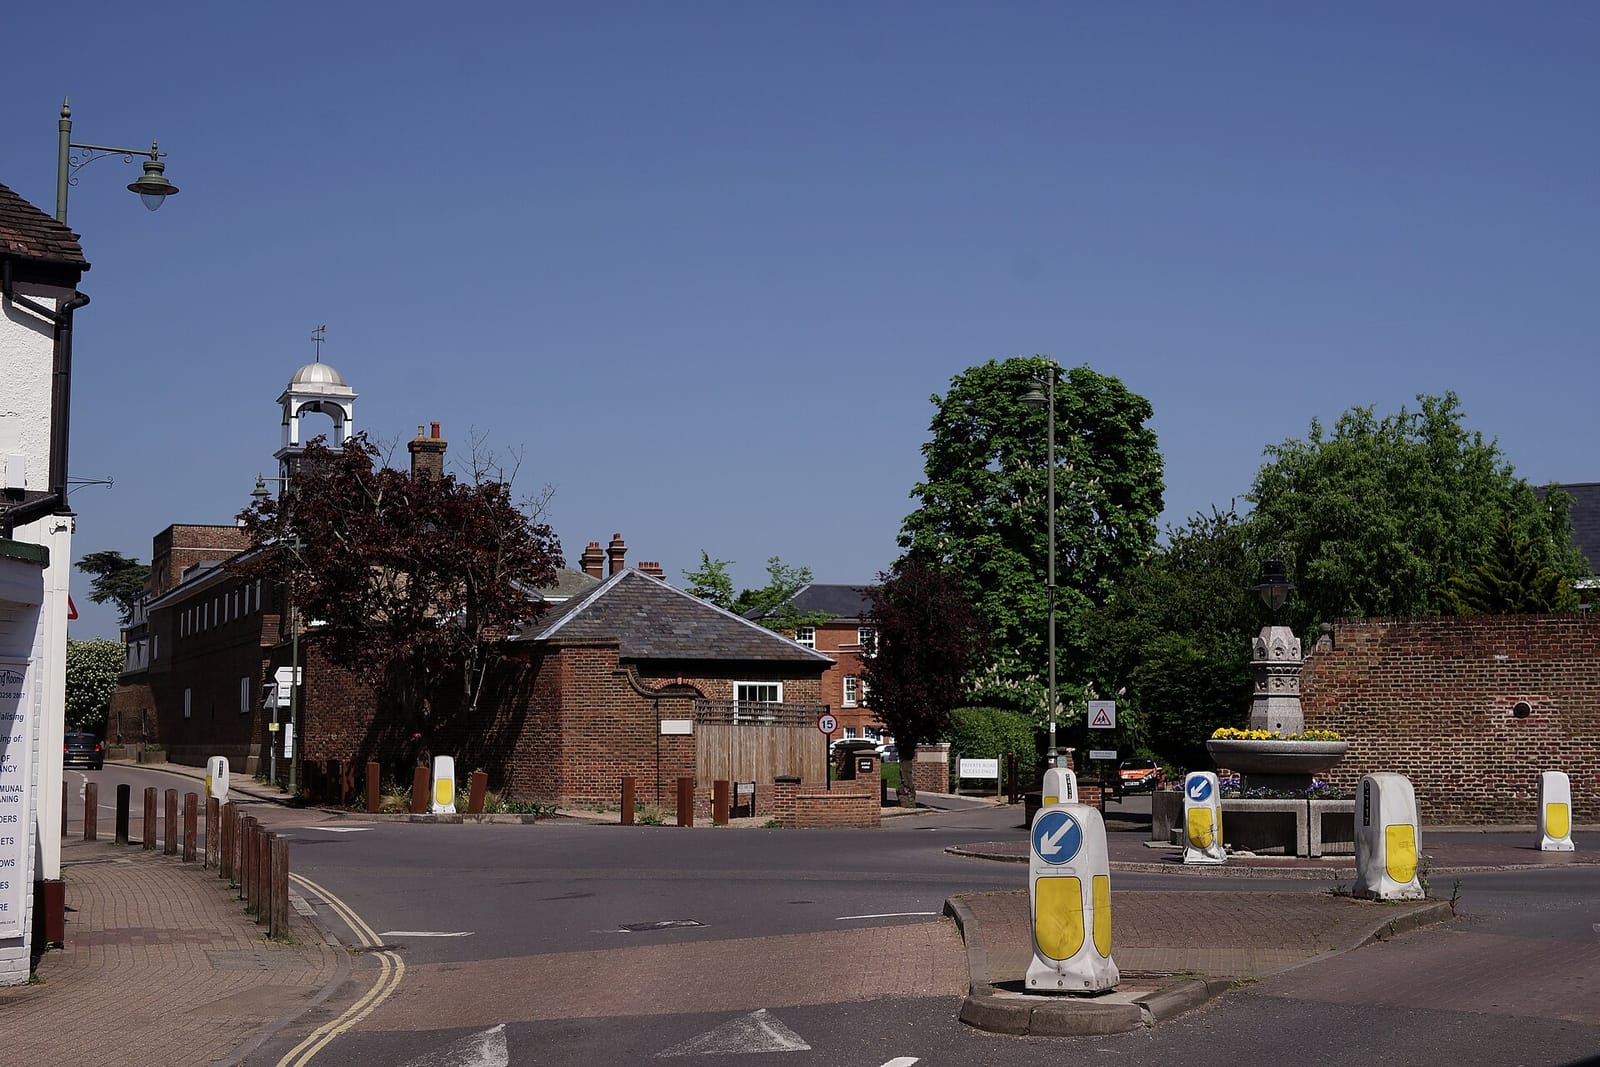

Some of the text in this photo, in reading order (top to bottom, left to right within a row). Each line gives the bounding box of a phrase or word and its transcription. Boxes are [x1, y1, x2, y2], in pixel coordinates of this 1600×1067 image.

[822, 720, 833, 729] 15
[1, 754, 10, 762] OF
[1, 837, 14, 845] ETS
